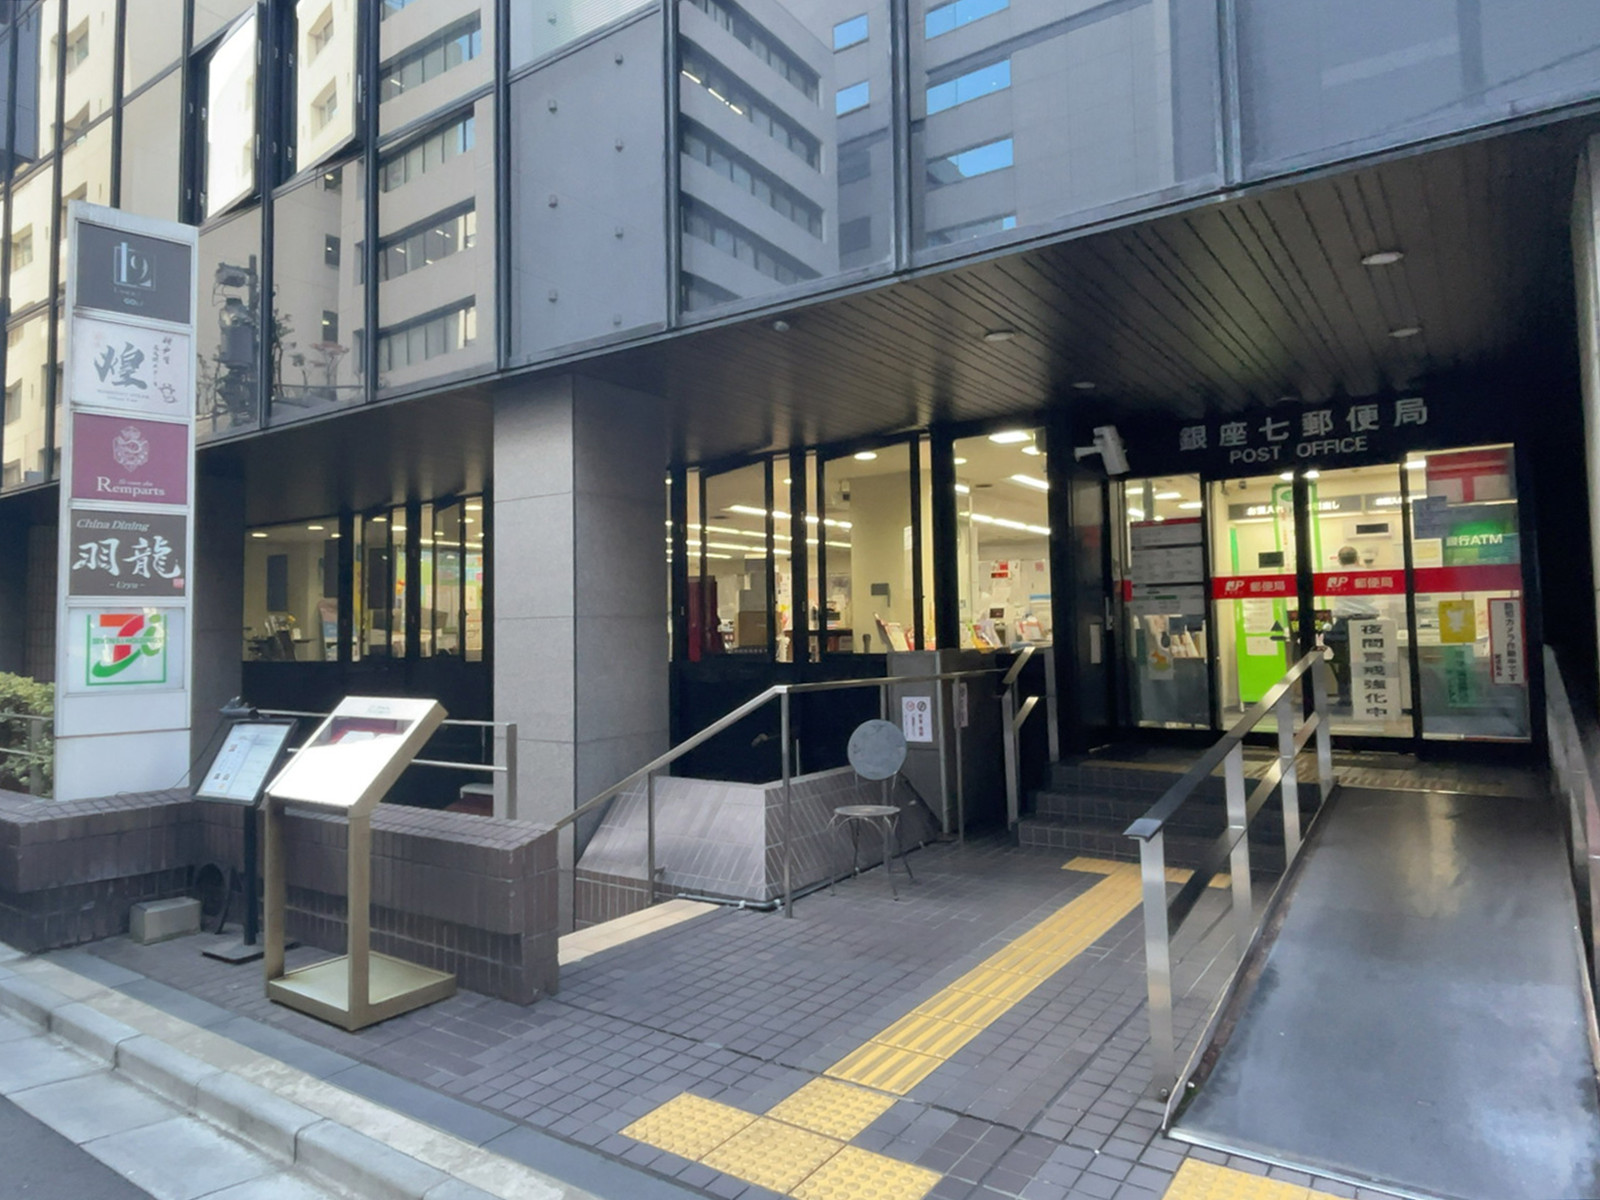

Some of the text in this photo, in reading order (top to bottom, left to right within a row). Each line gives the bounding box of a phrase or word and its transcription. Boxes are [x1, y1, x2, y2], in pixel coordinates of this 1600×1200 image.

[1179, 397, 1428, 450] 銀座七郵便局
[1229, 435, 1369, 464] POST OFFICE
[97, 476, 165, 497] Remparts
[76, 519, 150, 532] China Dining
[72, 535, 181, 579] 羽龍
[1250, 581, 1286, 593] 郵便局
[1354, 576, 1393, 589] 郵便局
[1360, 623, 1388, 718] 夜間警戒強化中
